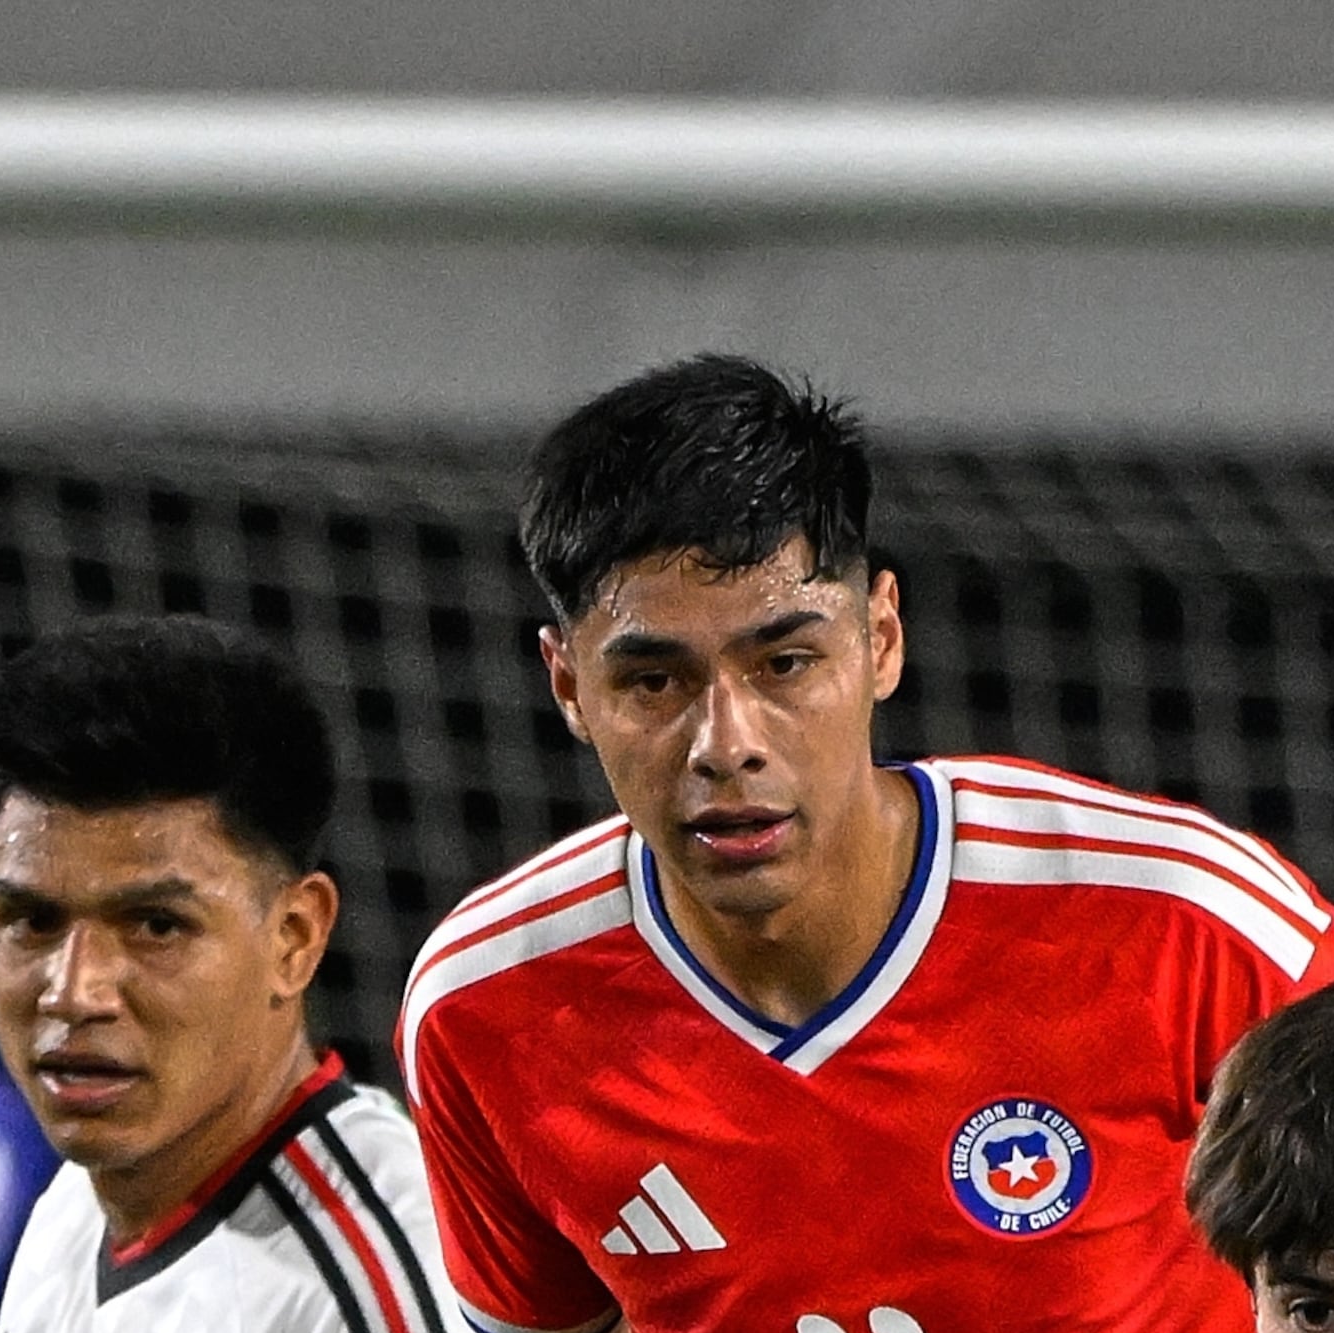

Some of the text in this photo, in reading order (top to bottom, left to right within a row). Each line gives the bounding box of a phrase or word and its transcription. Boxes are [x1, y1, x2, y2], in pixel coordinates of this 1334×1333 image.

[952, 1102, 1085, 1180] FEDERACION DE FUTBOL
[1000, 1199, 1070, 1231] DE CHILE
